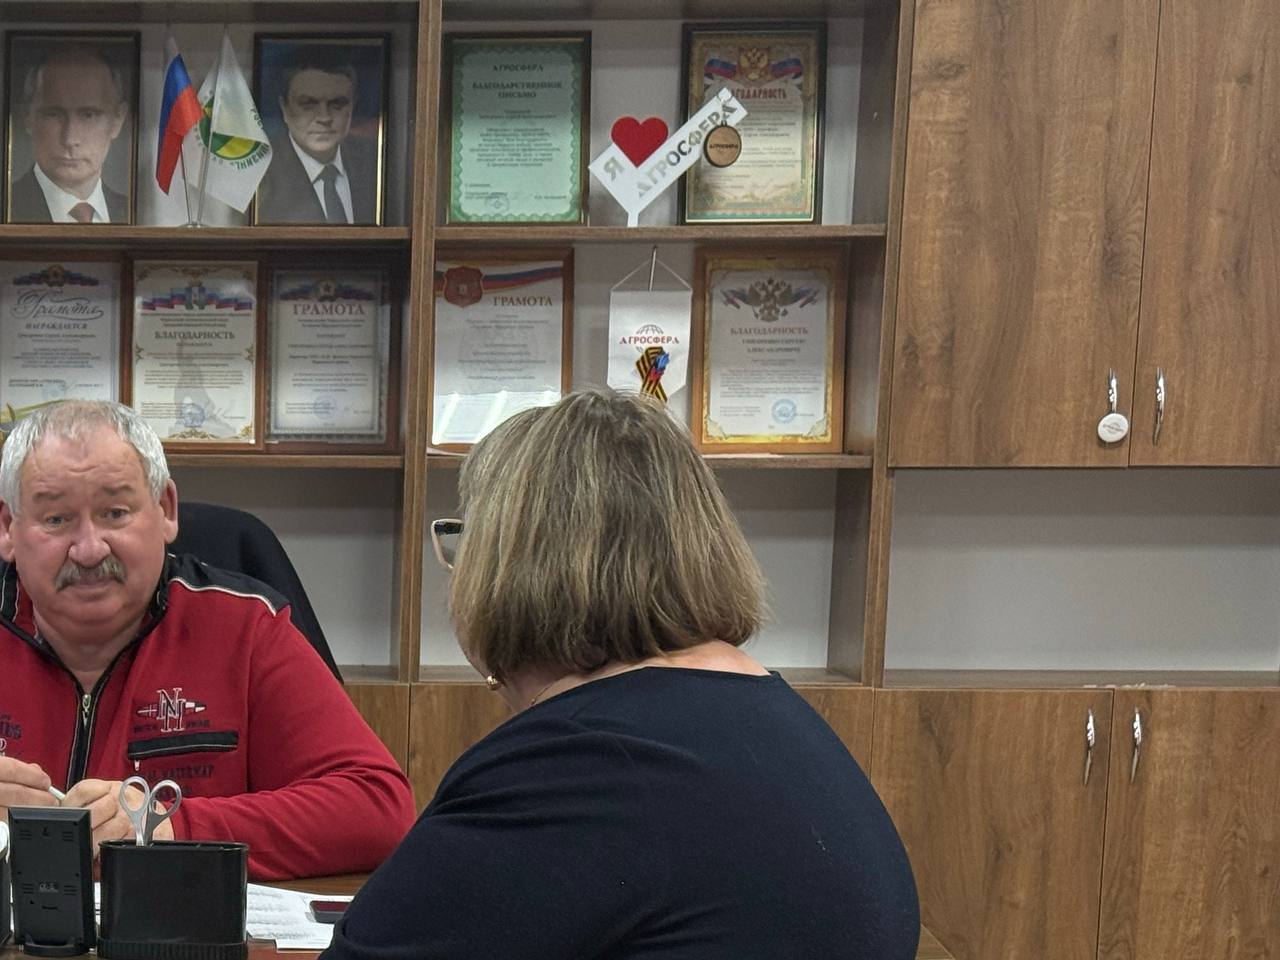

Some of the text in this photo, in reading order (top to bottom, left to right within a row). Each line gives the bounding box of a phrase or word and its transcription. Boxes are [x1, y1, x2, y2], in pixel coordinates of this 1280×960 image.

[603, 156, 625, 181] Я
[493, 295, 553, 307] ГРАМОТА
[293, 303, 365, 315] ГРАМОТА
[154, 331, 236, 340] БЛАГОДАРНОСТЬ
[730, 327, 808, 336] БЛАГОДАРНОСТЬ
[619, 335, 679, 345] АГРОСФЕРА
